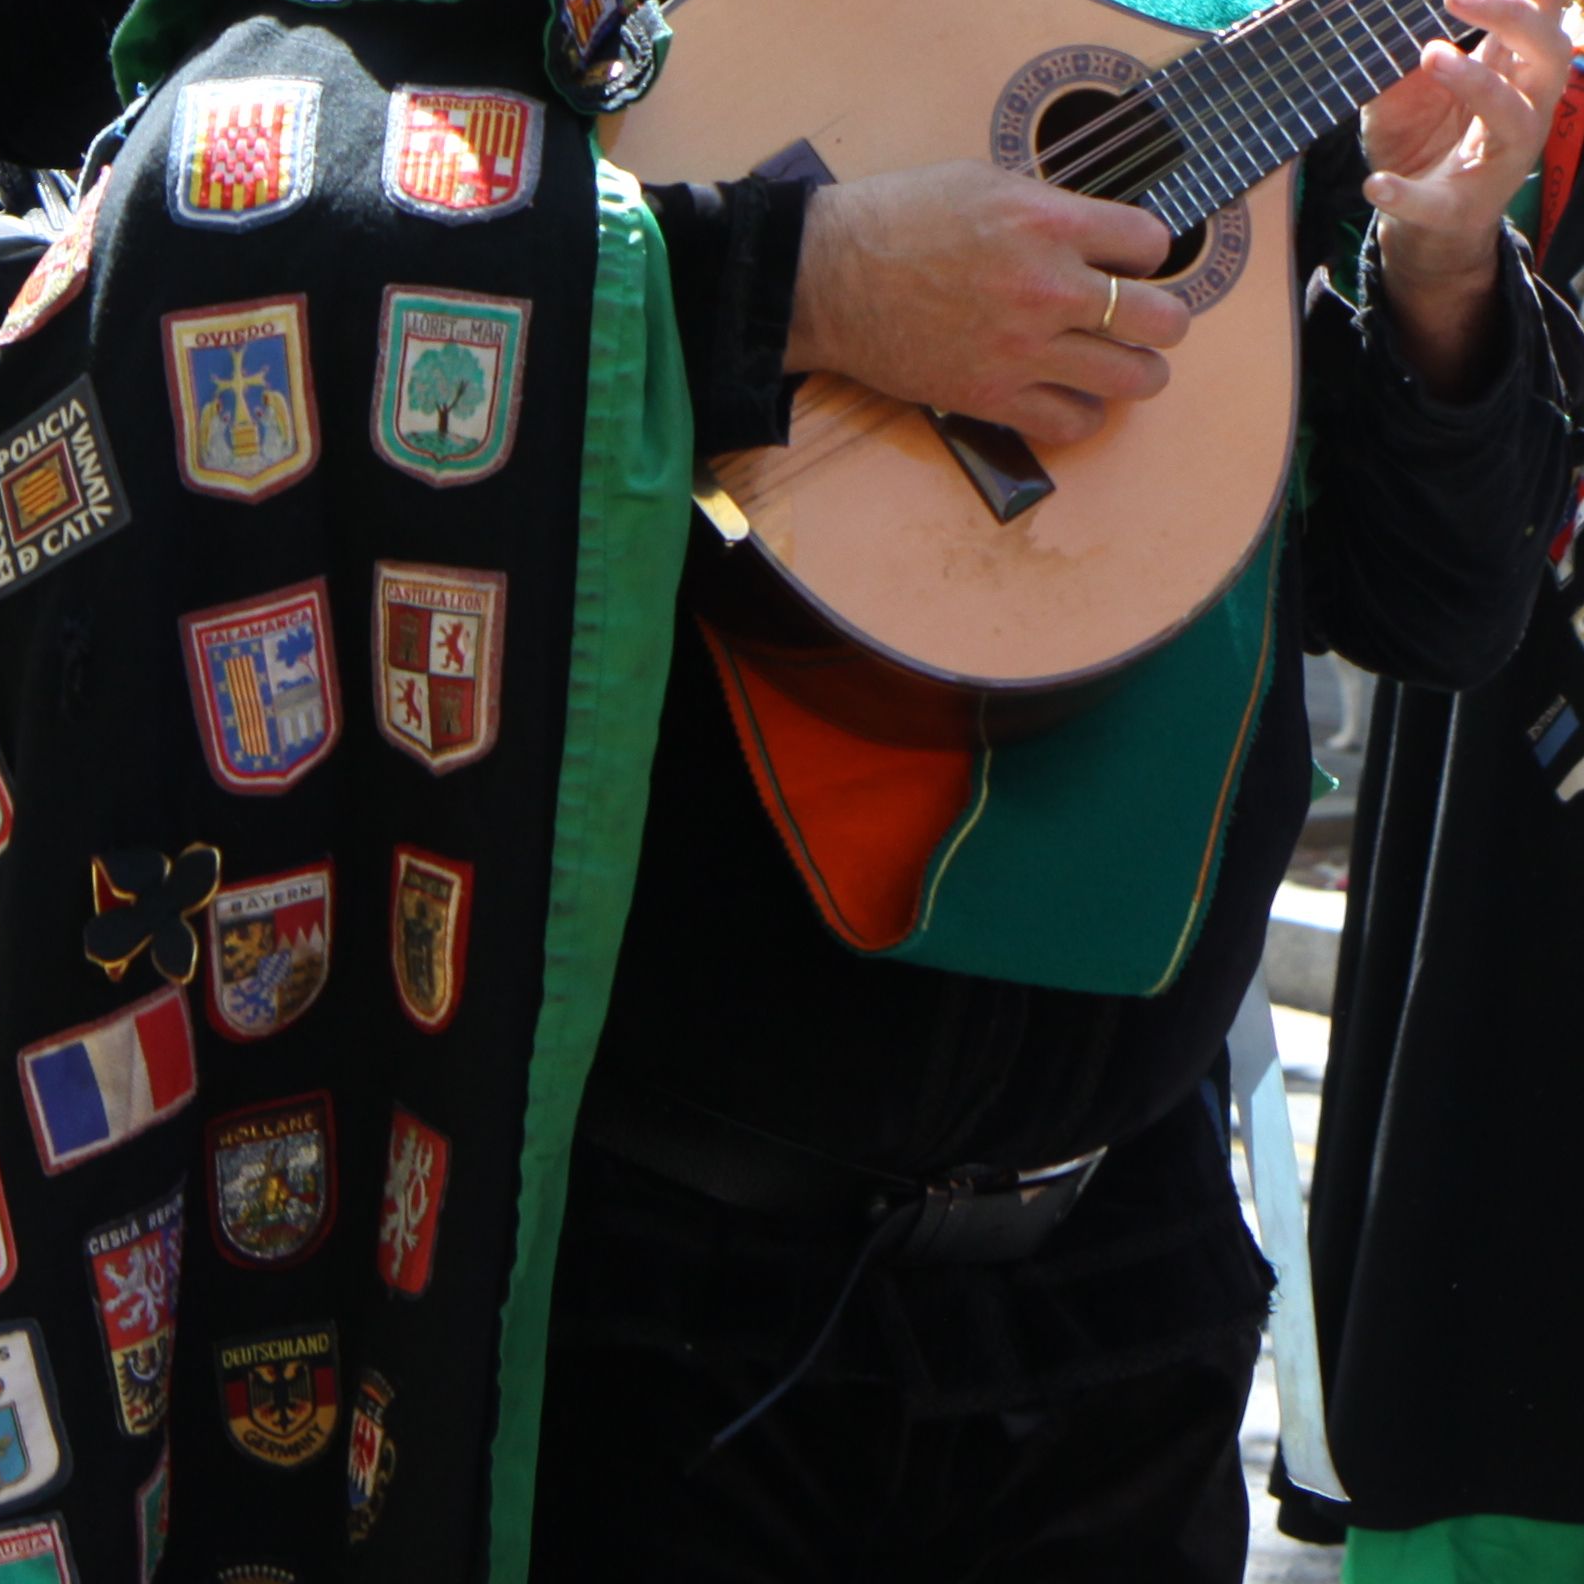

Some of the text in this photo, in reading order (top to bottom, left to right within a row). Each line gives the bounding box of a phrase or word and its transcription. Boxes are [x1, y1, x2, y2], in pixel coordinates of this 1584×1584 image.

[195, 322, 275, 347] OVIEDO
[205, 611, 312, 643] SALAMANCA
[230, 884, 313, 913] BAYERN
[221, 1330, 331, 1370] DEUTSCHLAND
